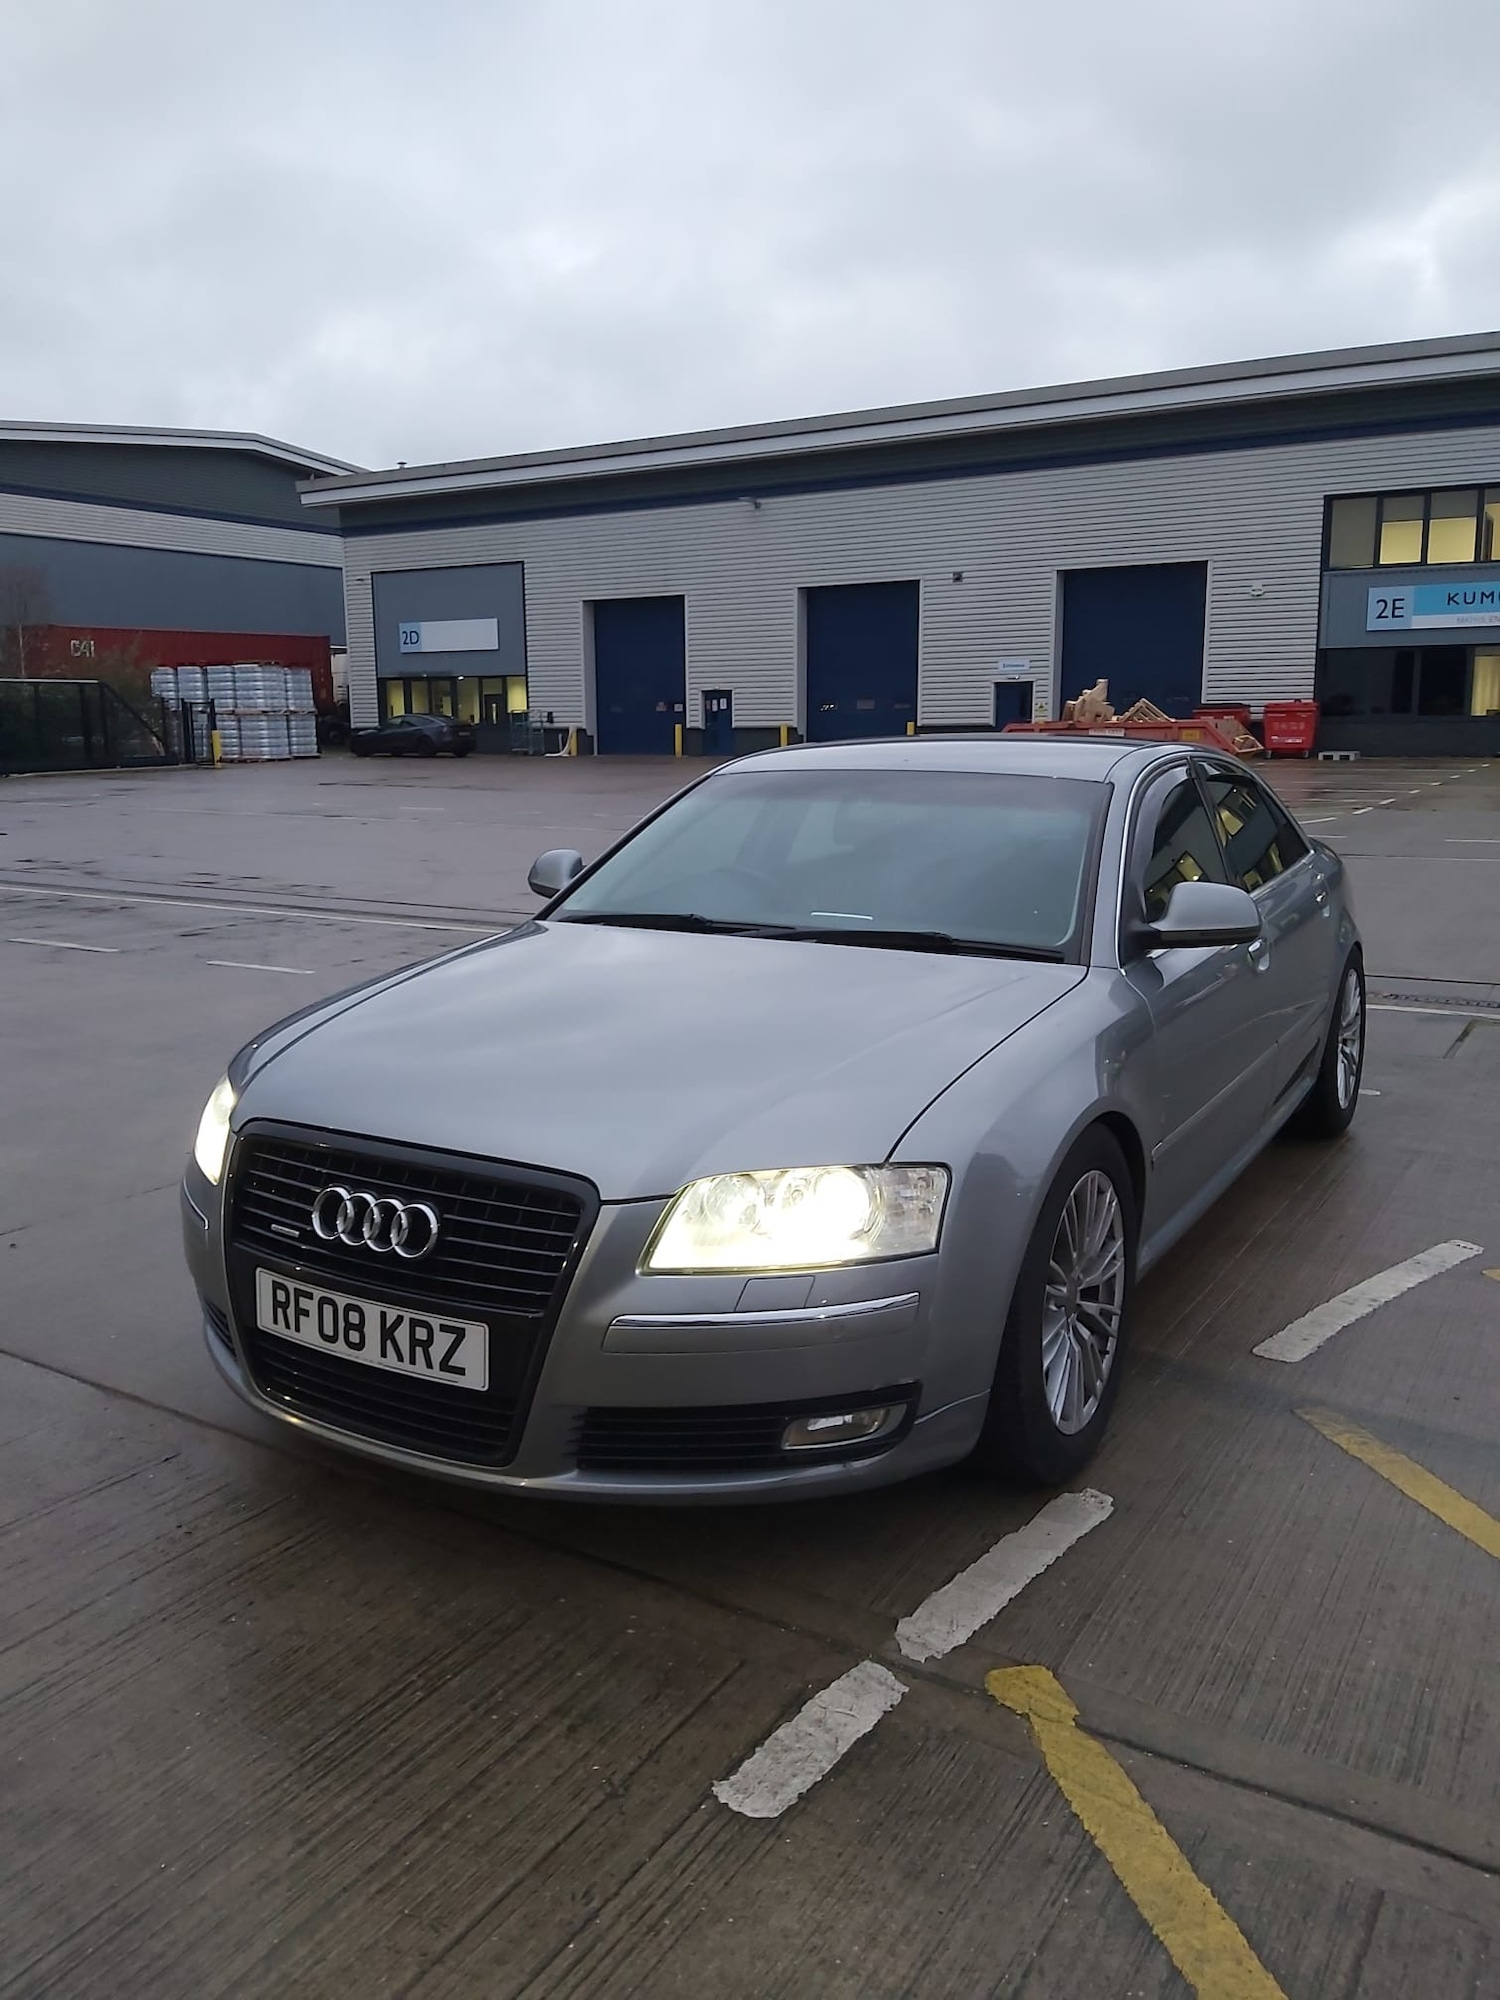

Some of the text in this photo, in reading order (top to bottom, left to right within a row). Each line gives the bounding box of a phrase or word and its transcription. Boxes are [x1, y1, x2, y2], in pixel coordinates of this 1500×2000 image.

[1447, 590, 1500, 606] KUM
[1375, 598, 1405, 619] 2E
[402, 630, 420, 645] 2D
[271, 1279, 466, 1377] RF08 KRZ
